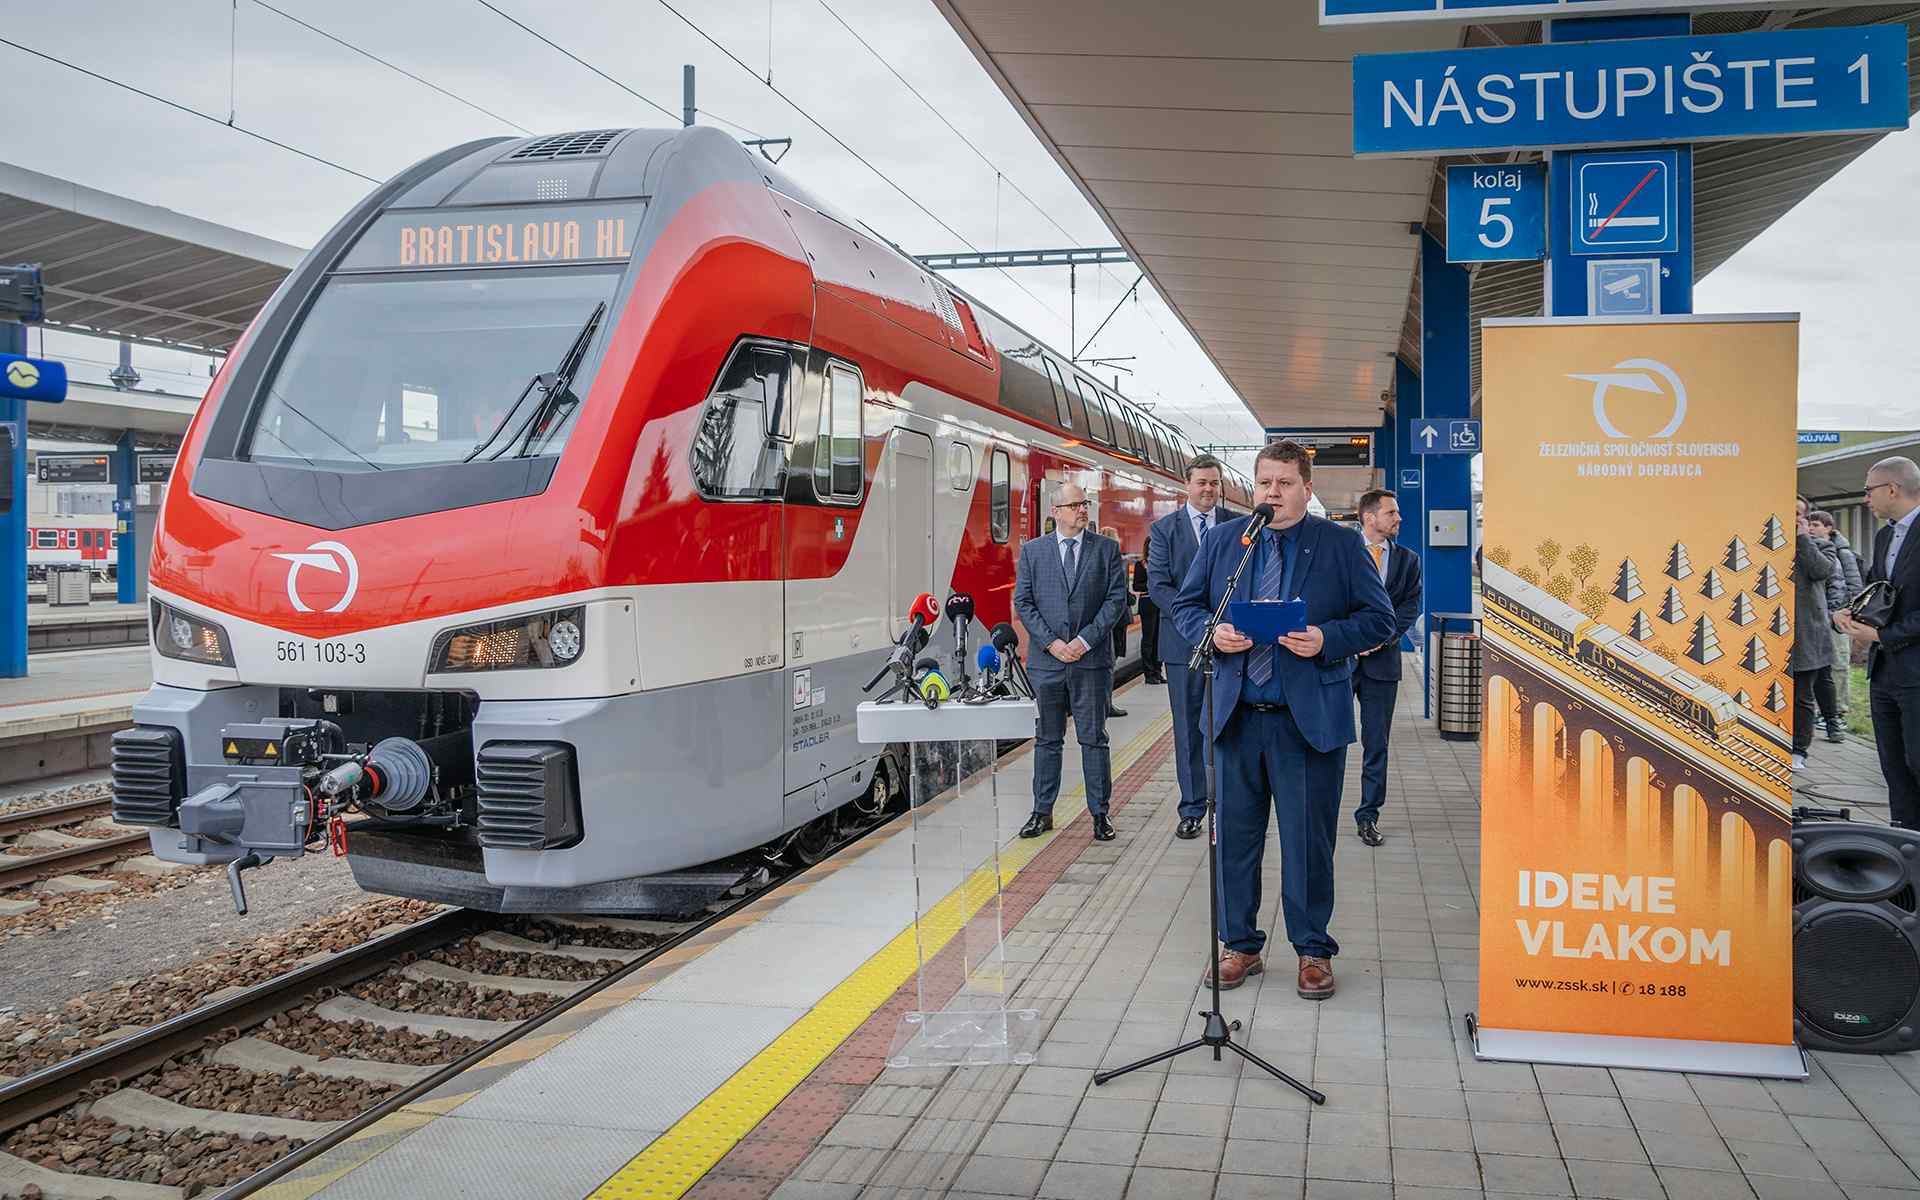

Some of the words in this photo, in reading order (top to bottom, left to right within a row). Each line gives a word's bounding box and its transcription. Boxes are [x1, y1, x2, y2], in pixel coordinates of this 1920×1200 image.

[1382, 51, 1817, 129] NÁSTUPIŠTE
[1847, 53, 1871, 104] 1
[1473, 170, 1521, 192] koľaj
[1478, 197, 1514, 249] 5
[400, 221, 580, 265] BRATISLAVA
[596, 218, 632, 257] HL
[1797, 432, 1838, 442] KÚJVÁR
[1538, 440, 1600, 457] ŽELEZNIČNÁ
[1603, 441, 1674, 457] SPOLOČNOSŤ
[1676, 442, 1740, 458] SLOVENSKO
[1576, 460, 1633, 477] NÁRODNÝ
[1638, 463, 1703, 477] DOPRAVCA
[277, 641, 305, 661] 561
[314, 642, 366, 664] 103-3
[792, 731, 831, 753] STADLER
[1518, 870, 1677, 914] IDEME
[1515, 919, 1732, 967] VLAKOM
[1515, 977, 1609, 993] www.zssk.sk
[1639, 984, 1656, 996] 18
[1660, 984, 1687, 997] 188
